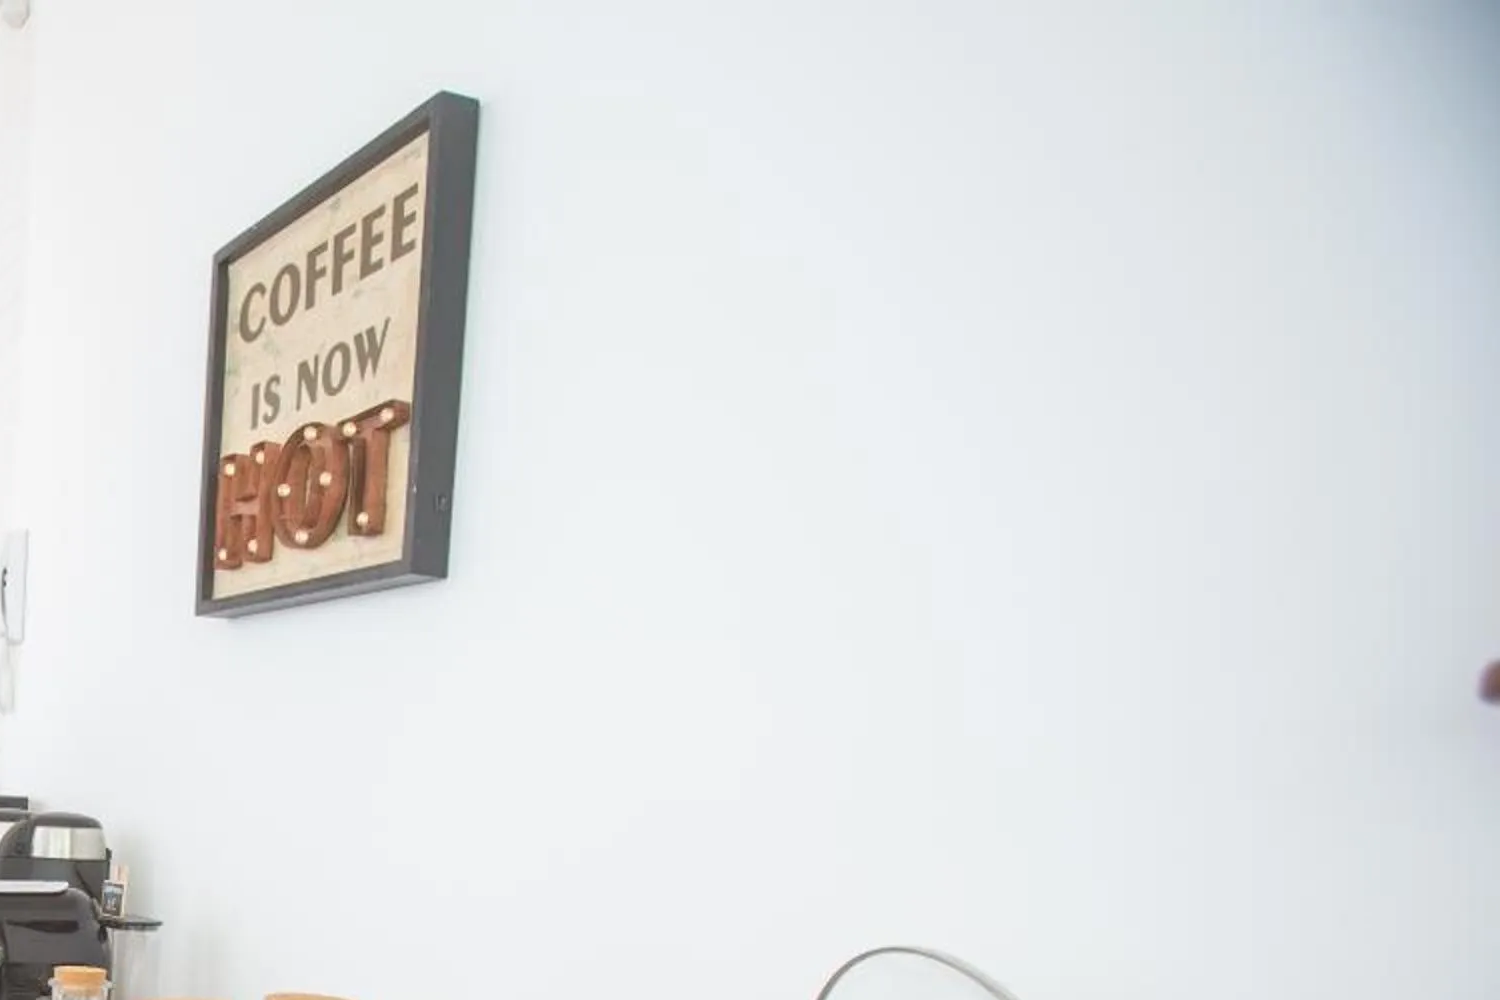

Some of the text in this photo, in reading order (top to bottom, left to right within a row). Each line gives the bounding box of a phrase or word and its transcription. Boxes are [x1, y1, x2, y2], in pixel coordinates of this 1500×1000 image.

[237, 182, 419, 344] COFFEE
[250, 316, 391, 431] IS NOW
[214, 398, 411, 570] HOT
